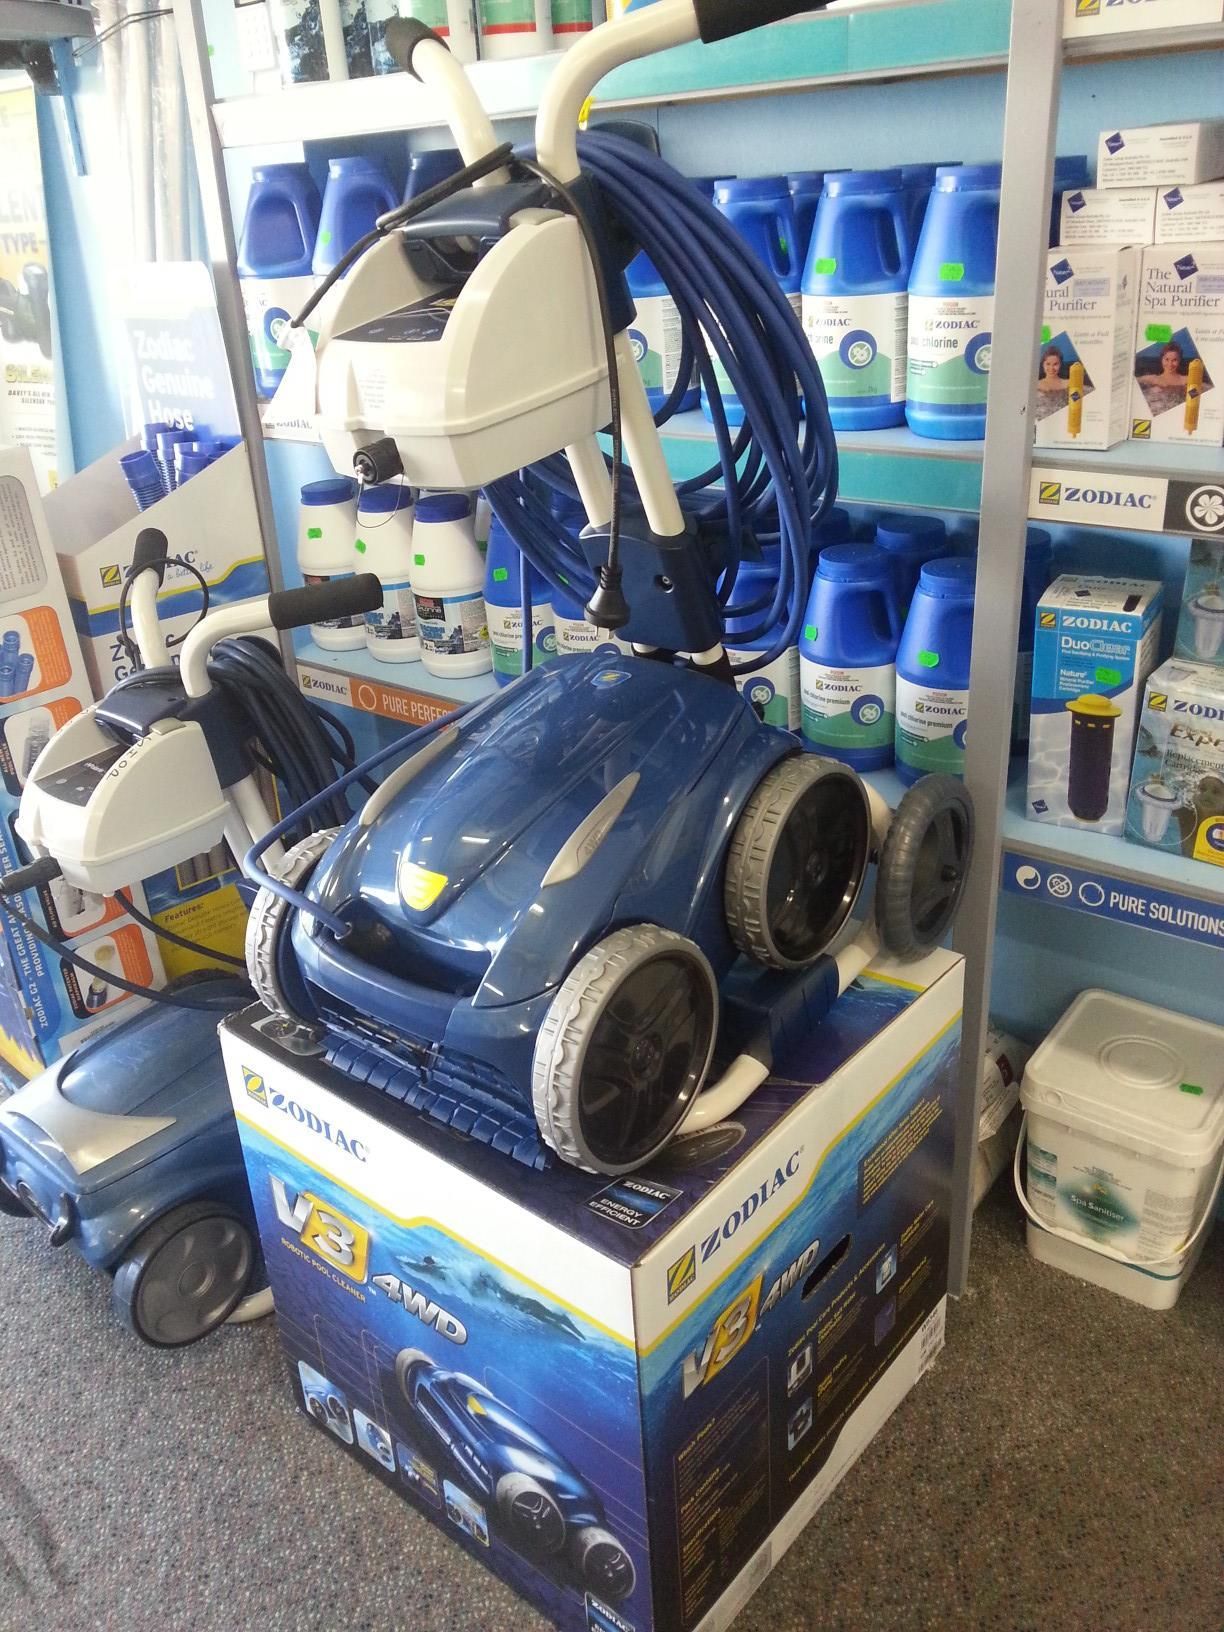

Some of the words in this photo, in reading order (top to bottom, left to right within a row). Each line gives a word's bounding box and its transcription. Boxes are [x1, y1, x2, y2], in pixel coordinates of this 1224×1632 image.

[1147, 268, 1172, 280] The
[1146, 282, 1192, 293] Natural
[1049, 299, 1097, 311] Purifier
[1145, 295, 1166, 309] Spa
[1171, 295, 1220, 307] Purifier
[936, 321, 978, 329] ZODIAC
[133, 331, 194, 361] Zodiac
[142, 364, 214, 399] Genuine
[150, 402, 194, 431] Hose
[1065, 488, 1152, 508] ZODIAC
[1062, 616, 1132, 633] ZODIAC
[312, 679, 347, 695] ZODIAC
[824, 683, 862, 692] ZODIAC
[382, 694, 409, 715] PURE
[925, 705, 966, 715] ZODIAC
[107, 737, 151, 780] SHOP
[1110, 892, 1147, 916] PURE
[1149, 902, 1224, 937] SOLUTIONS
[11, 928, 27, 957] GREAT
[19, 959, 32, 977] THE
[33, 994, 48, 1028] ZODIAC
[269, 1087, 367, 1162] ZODIAC
[623, 1181, 671, 1199] ZODIAC
[269, 1172, 356, 1266] V3
[588, 1201, 641, 1225] EFFICIENT
[600, 1198, 644, 1218] ENERGY
[701, 1151, 801, 1264] ZODIAC
[1071, 1195, 1087, 1208] Spa
[1088, 1202, 1125, 1222] Sanitiser
[281, 1237, 311, 1264] ROBOTIC
[312, 1259, 331, 1278] POOL
[332, 1274, 366, 1304] CLEANER
[760, 1240, 821, 1318] 4WD
[371, 1272, 468, 1345] 4WD
